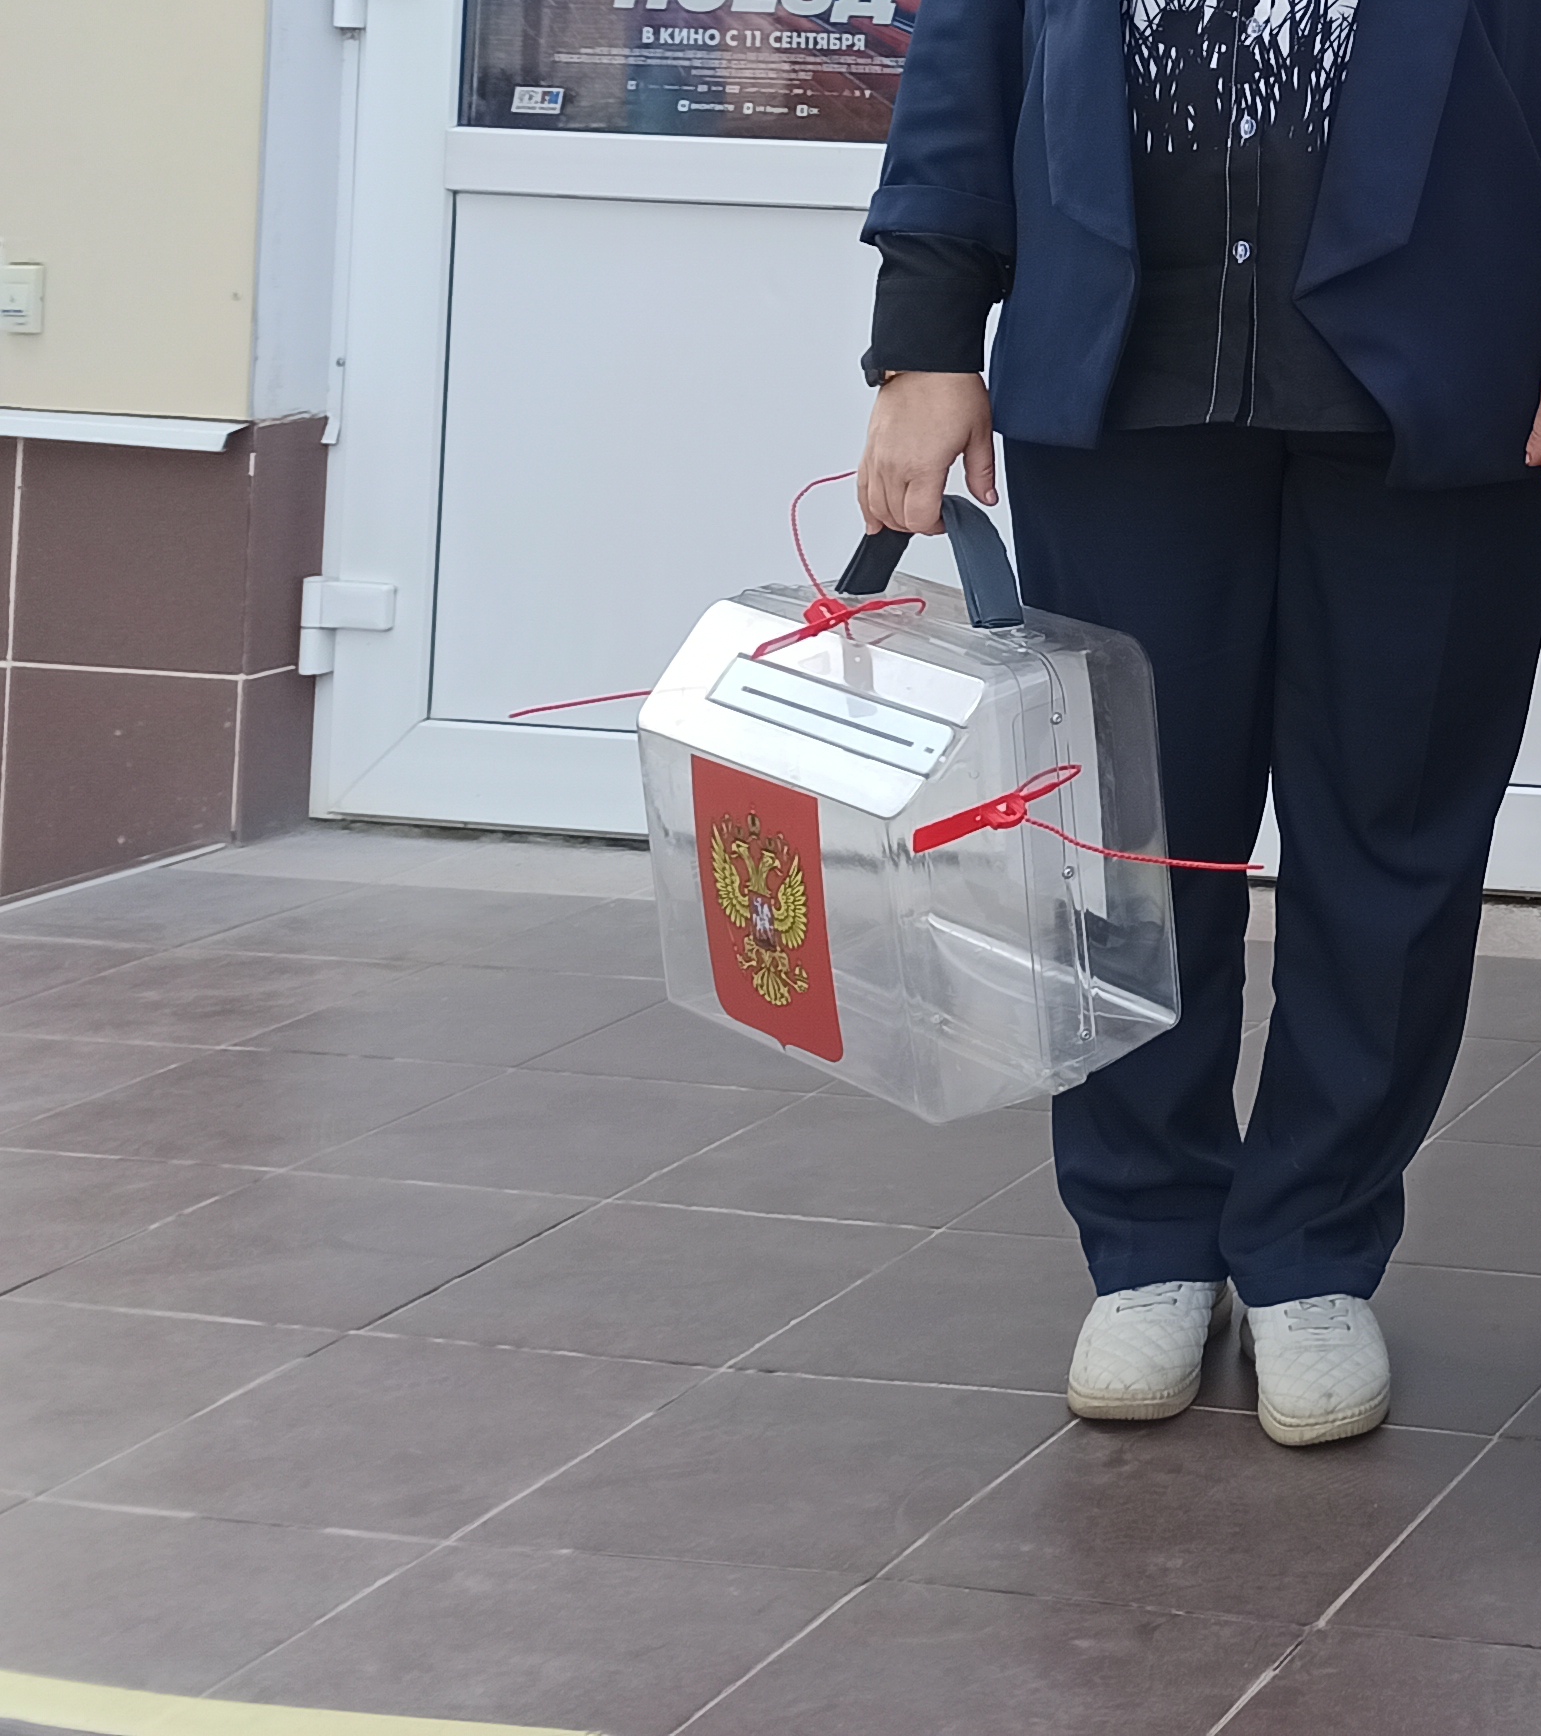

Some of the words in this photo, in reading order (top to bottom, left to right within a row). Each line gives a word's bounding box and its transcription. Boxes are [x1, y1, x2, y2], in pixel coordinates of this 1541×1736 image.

[641, 27, 655, 45] В
[659, 28, 721, 47] КИНО
[726, 30, 739, 47] С
[744, 30, 762, 48] 11
[769, 30, 867, 51] СЕНТЯБРЯ
